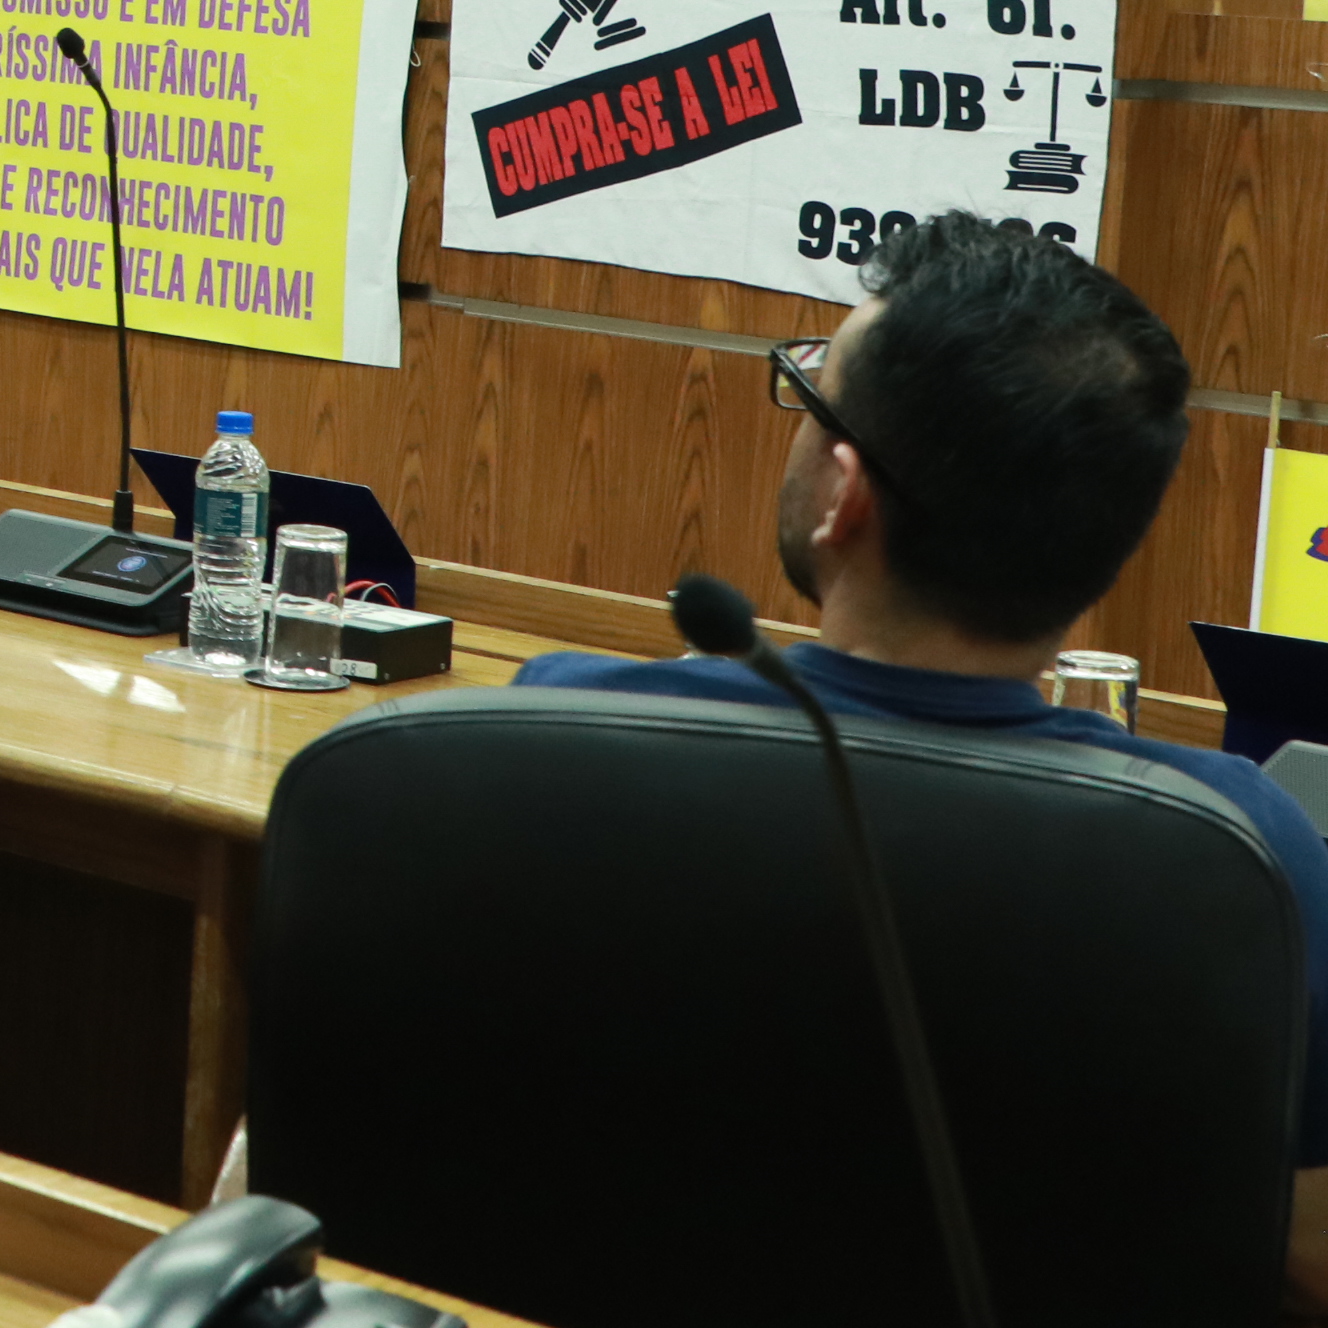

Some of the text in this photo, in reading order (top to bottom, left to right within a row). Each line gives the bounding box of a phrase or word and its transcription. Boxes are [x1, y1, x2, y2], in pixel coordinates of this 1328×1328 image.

[113, 39, 258, 111] INFÂNCIA,
[858, 68, 986, 132] LDB
[59, 103, 94, 154] DE
[487, 37, 779, 197] CUMPRA-SE A LEI
[0, 164, 17, 211] E
[24, 166, 286, 247] RECONHECIMENTO
[49, 236, 106, 292] QUE
[119, 246, 185, 302] NELA
[196, 256, 314, 321] ATUAM!
